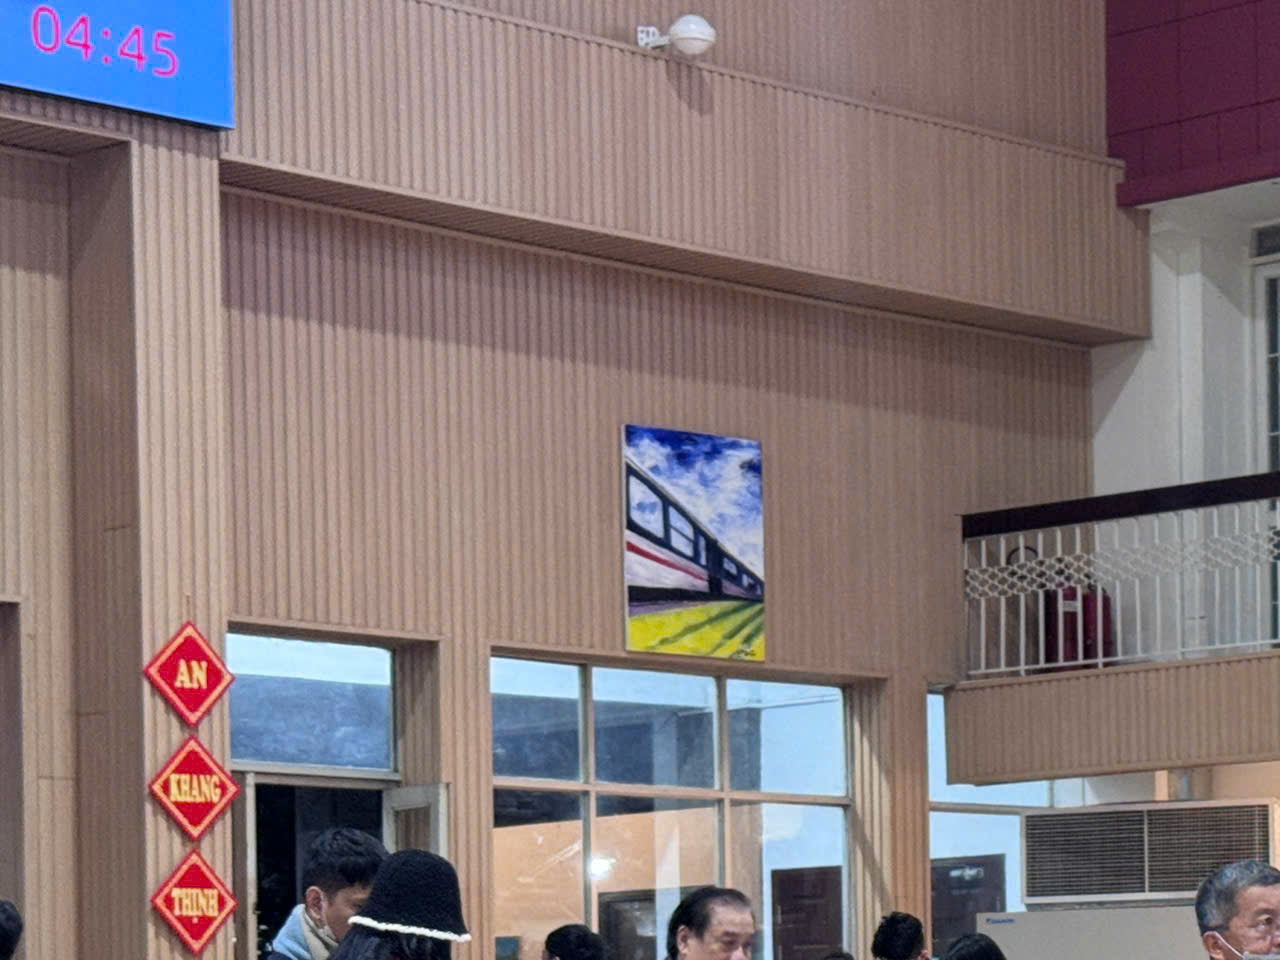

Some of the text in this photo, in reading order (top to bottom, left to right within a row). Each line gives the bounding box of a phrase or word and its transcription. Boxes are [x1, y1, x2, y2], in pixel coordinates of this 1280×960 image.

[31, 5, 180, 78] 04:45
[174, 660, 207, 689] AN
[169, 773, 221, 803] KHANG
[172, 888, 219, 924] THỊNH
